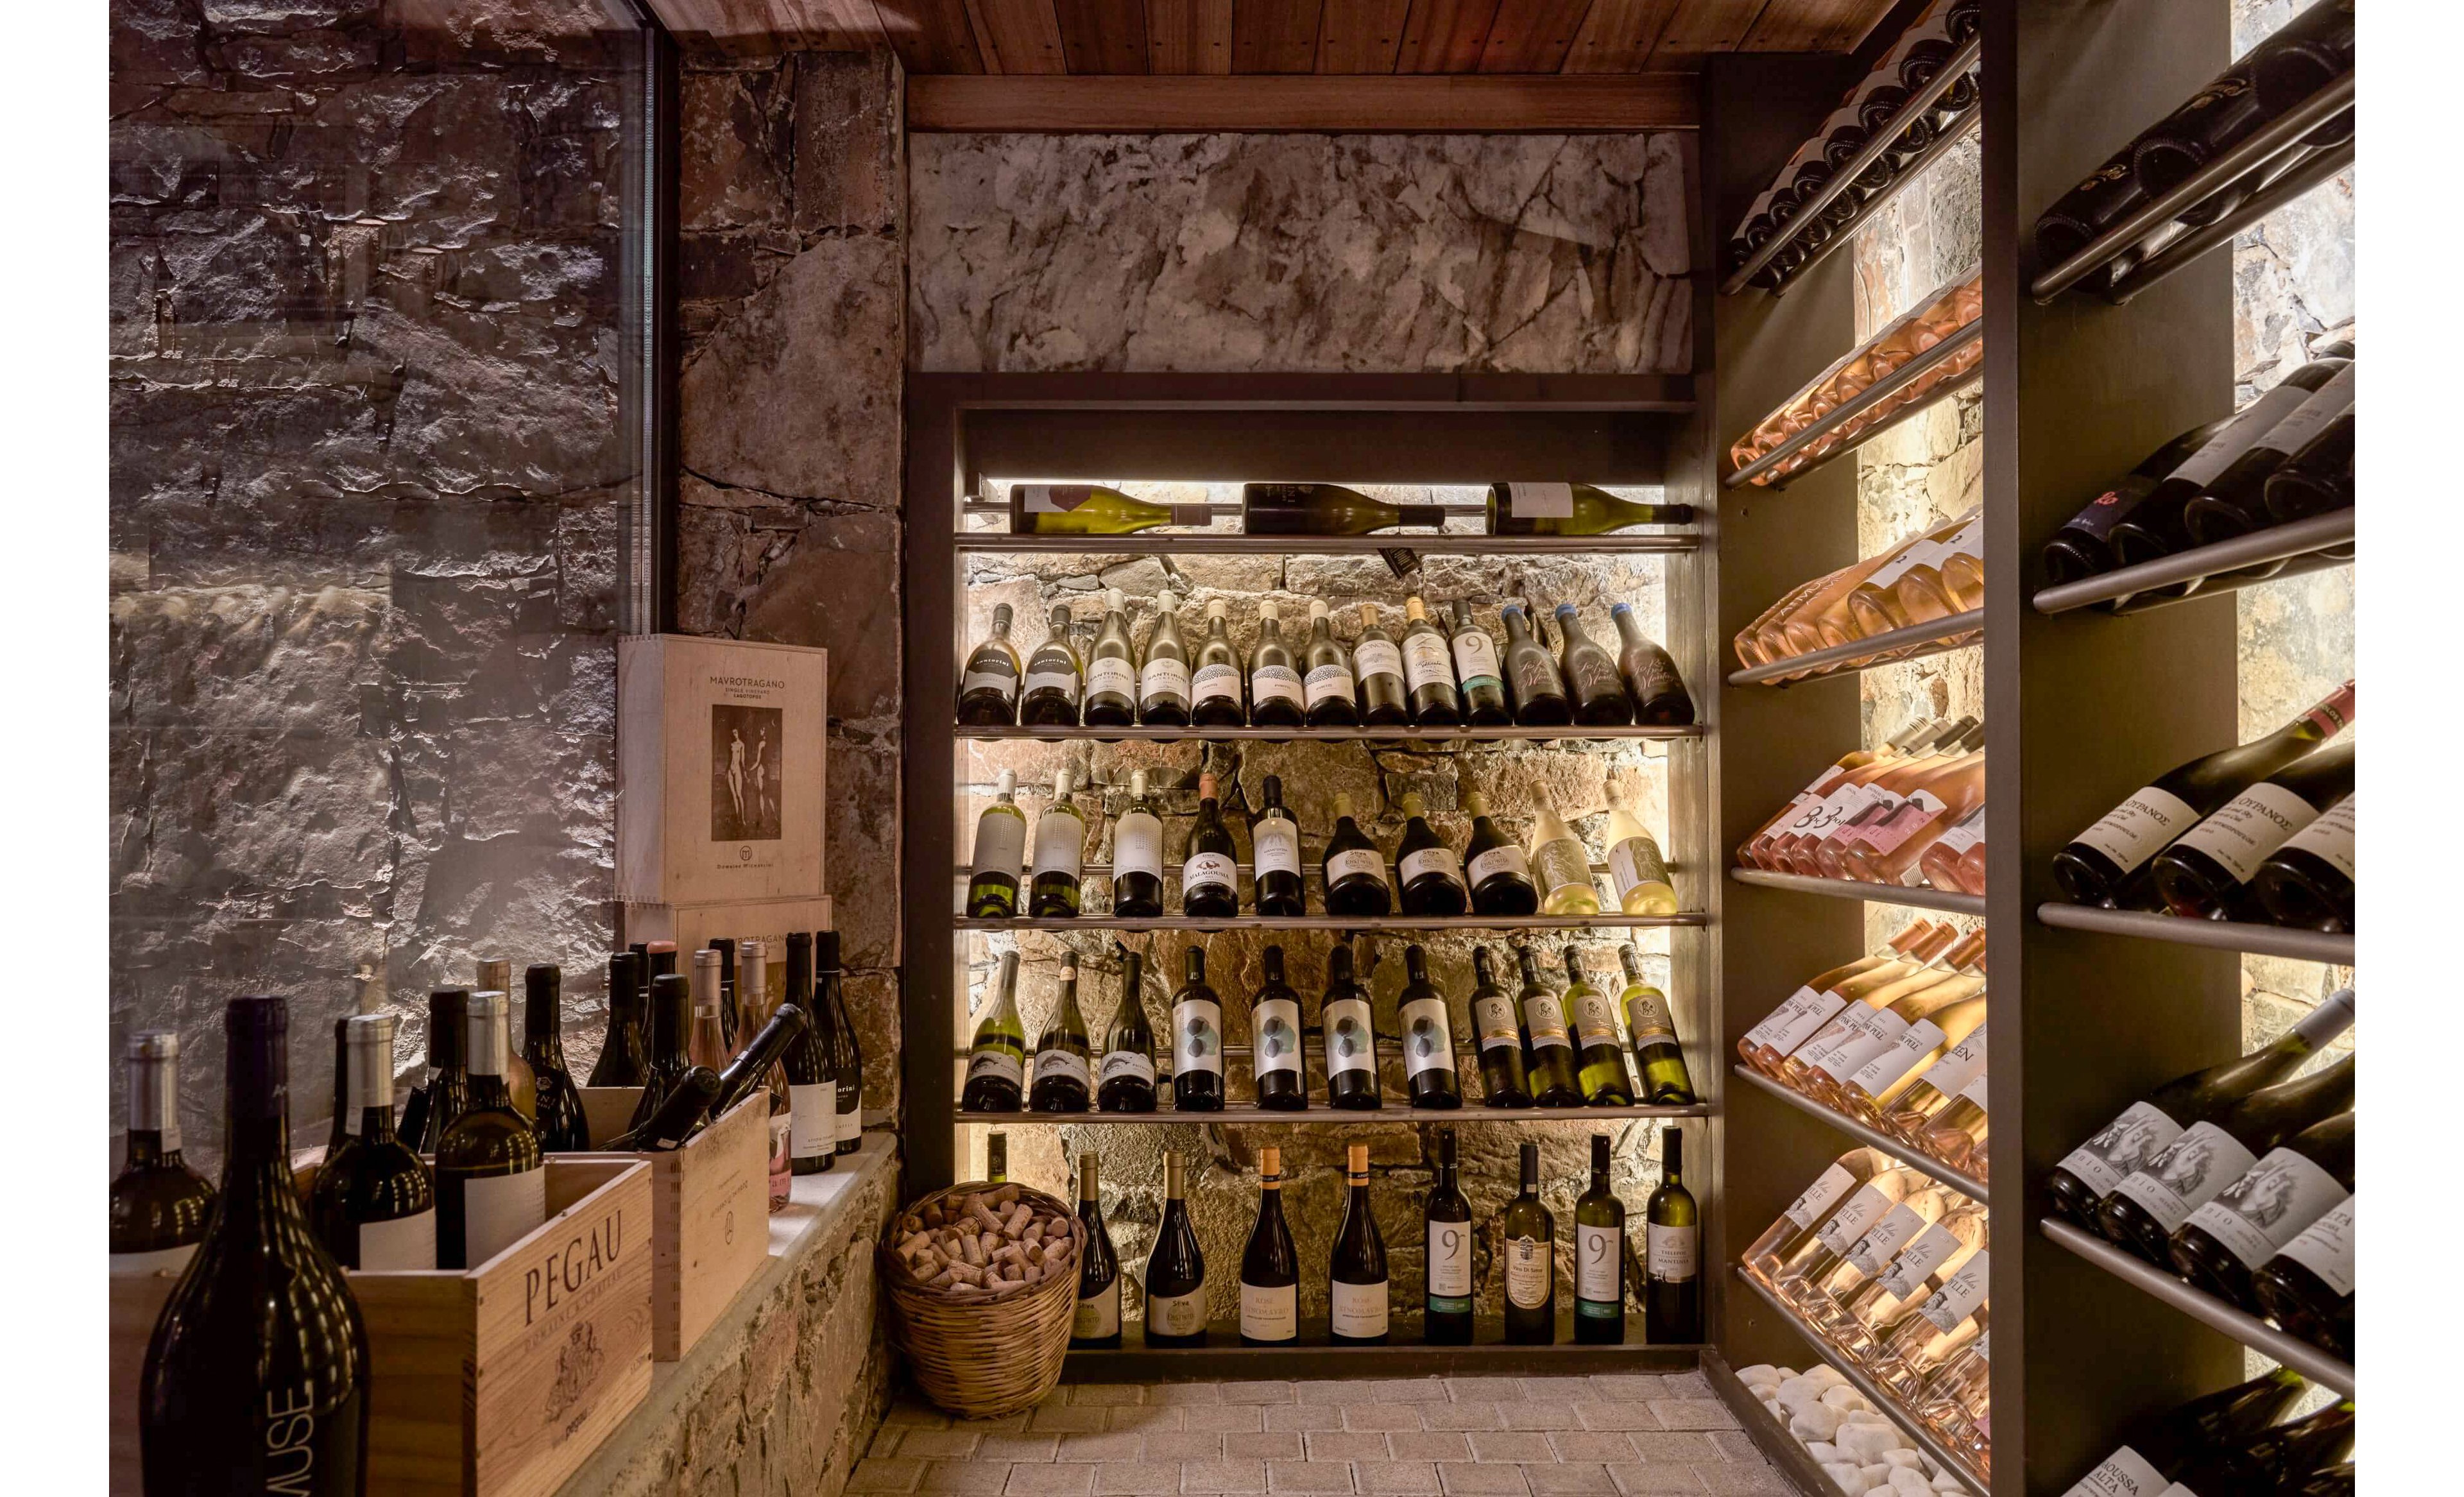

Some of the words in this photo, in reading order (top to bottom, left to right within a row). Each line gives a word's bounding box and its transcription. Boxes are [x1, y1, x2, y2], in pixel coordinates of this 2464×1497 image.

[1466, 636, 1484, 654] 9
[710, 676, 785, 690] MAVROTRAGANO
[1090, 671, 1129, 683] SANTORINI
[1147, 672, 1187, 684] SANTORINI
[2238, 797, 2293, 831] ΟΥΡΑΝΟΣ
[1189, 871, 1229, 882] MALAGOUSIA
[1952, 1045, 1974, 1062] EEN
[837, 1084, 855, 1093] orini
[1442, 1229, 1466, 1261] 9
[1588, 1233, 1614, 1265] 9
[525, 1210, 622, 1327] PEGAU
[2094, 1470, 2119, 1494] ALTA
[2101, 1460, 2139, 1496] AOUSSA
